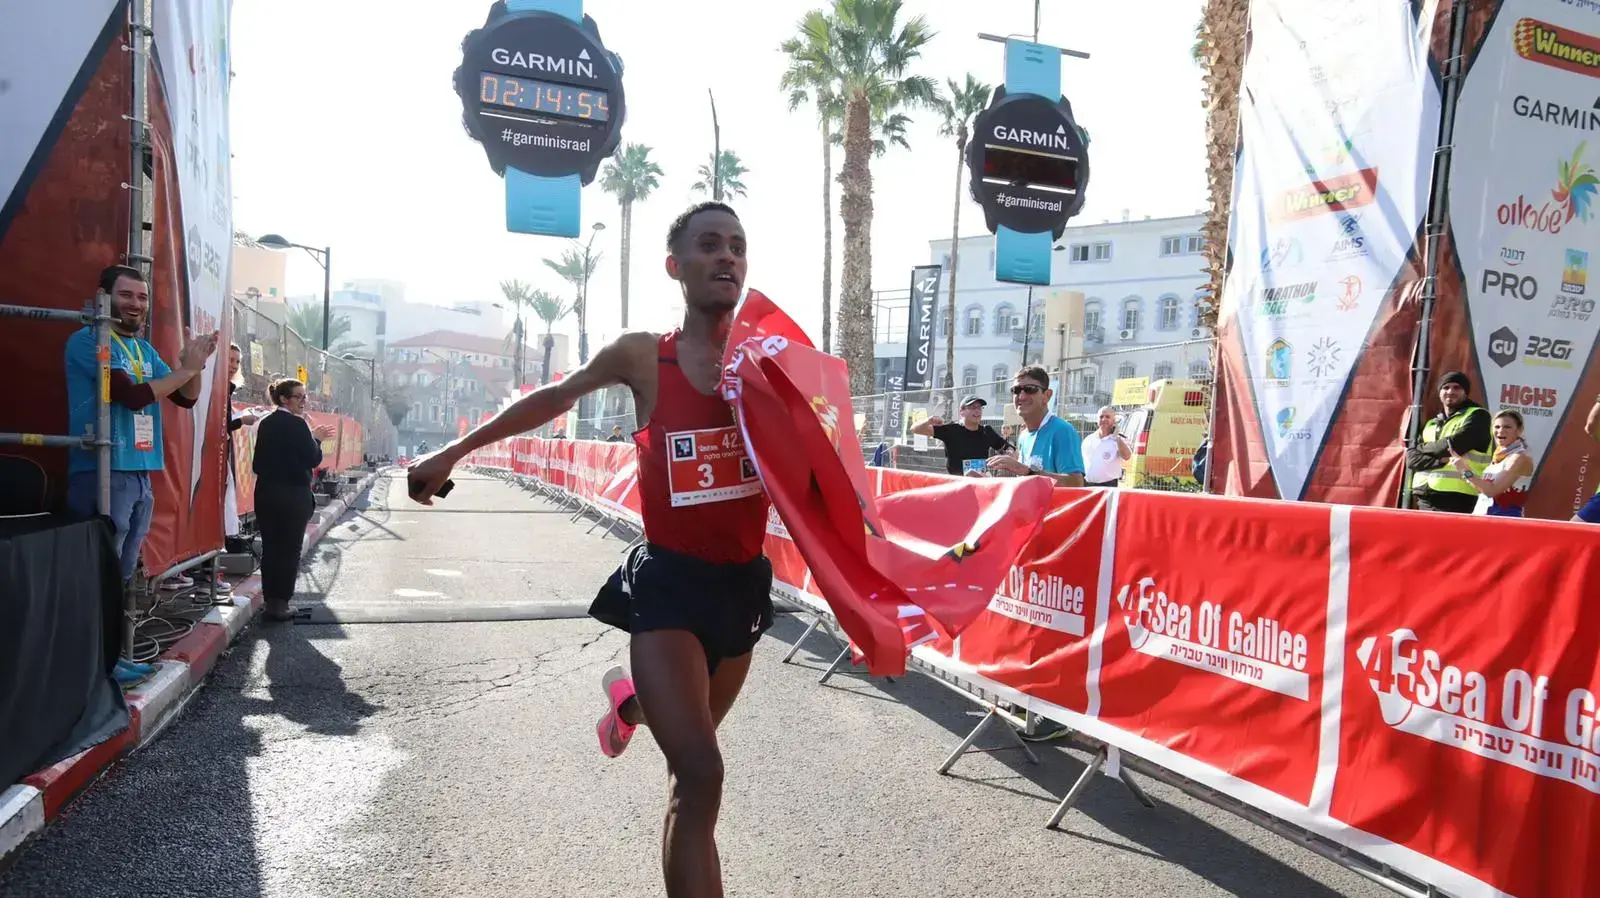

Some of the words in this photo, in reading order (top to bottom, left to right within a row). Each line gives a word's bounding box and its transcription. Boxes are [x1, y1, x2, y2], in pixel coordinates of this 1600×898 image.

[1535, 27, 1600, 66] Winner
[491, 48, 593, 78] GARMIN
[501, 128, 591, 152] #garminisrael
[993, 125, 1067, 150] GARMIN
[996, 193, 1062, 212] #garminisrael
[1482, 269, 1538, 301] PRO
[916, 276, 937, 375] GARMIN
[1491, 339, 1516, 356] GU
[890, 376, 904, 428] GARMIN
[1500, 383, 1557, 408] HIGH5
[1522, 406, 1554, 418] NUTRITION
[697, 463, 715, 488] 3
[1573, 453, 1589, 514] EDIA.CO.IL
[1009, 564, 1024, 601] Of
[1028, 571, 1084, 614] Galilee
[1152, 591, 1192, 641] Sea
[1198, 600, 1222, 649] Of
[1228, 611, 1308, 671] Galilee
[1170, 643, 1203, 663] טבריה
[1206, 652, 1228, 670] ווינר
[1231, 659, 1263, 681] מרתון
[1415, 649, 1487, 722] Sea
[1501, 668, 1549, 738] Of
[1454, 723, 1514, 755] טבריה
[1519, 742, 1563, 771] ווינר
